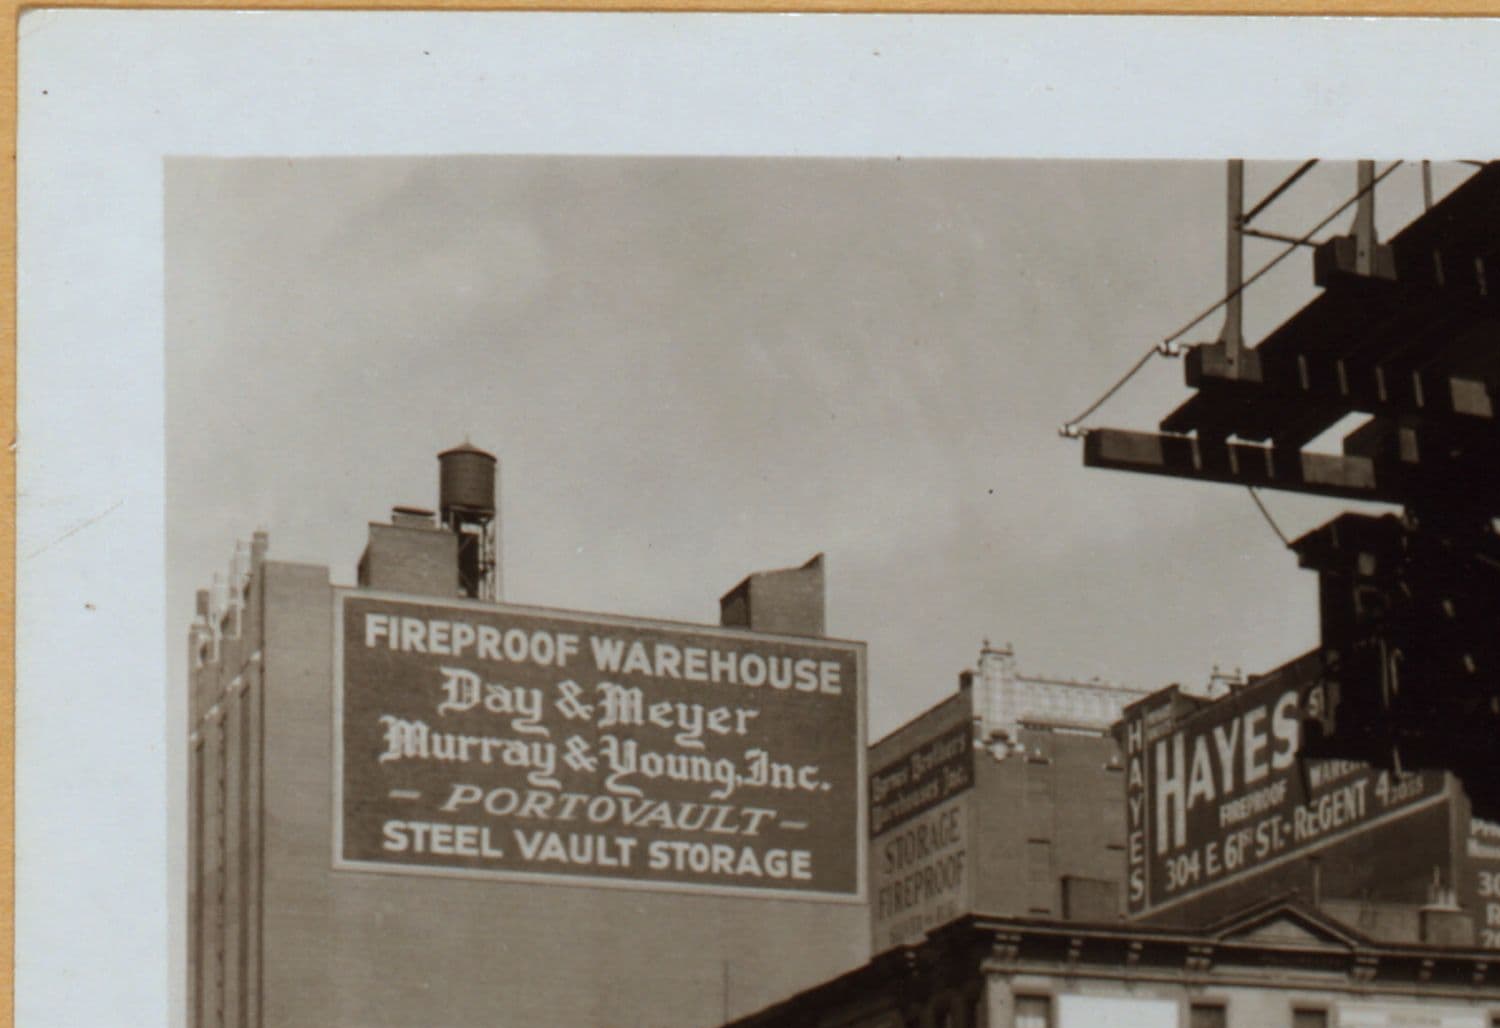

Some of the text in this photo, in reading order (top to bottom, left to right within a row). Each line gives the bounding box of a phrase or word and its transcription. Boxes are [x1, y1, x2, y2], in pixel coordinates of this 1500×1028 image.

[365, 614, 842, 694] FIREPROOF WAREHOUSE
[438, 666, 760, 748] Day & Meyer
[378, 714, 562, 790] Murray
[563, 735, 598, 773] &
[741, 748, 832, 792] Inc.
[1155, 689, 1300, 856] HAYES
[441, 783, 777, 837] PORTOVAULT
[883, 805, 960, 875] STORAGE
[1127, 719, 1143, 903] HAYES
[1165, 849, 1201, 892] 304
[1294, 776, 1368, 841] REGENT
[1375, 769, 1389, 806] 4
[382, 820, 813, 881] STEEL VAULT STORAGE
[878, 849, 966, 922] FIREPROOF
